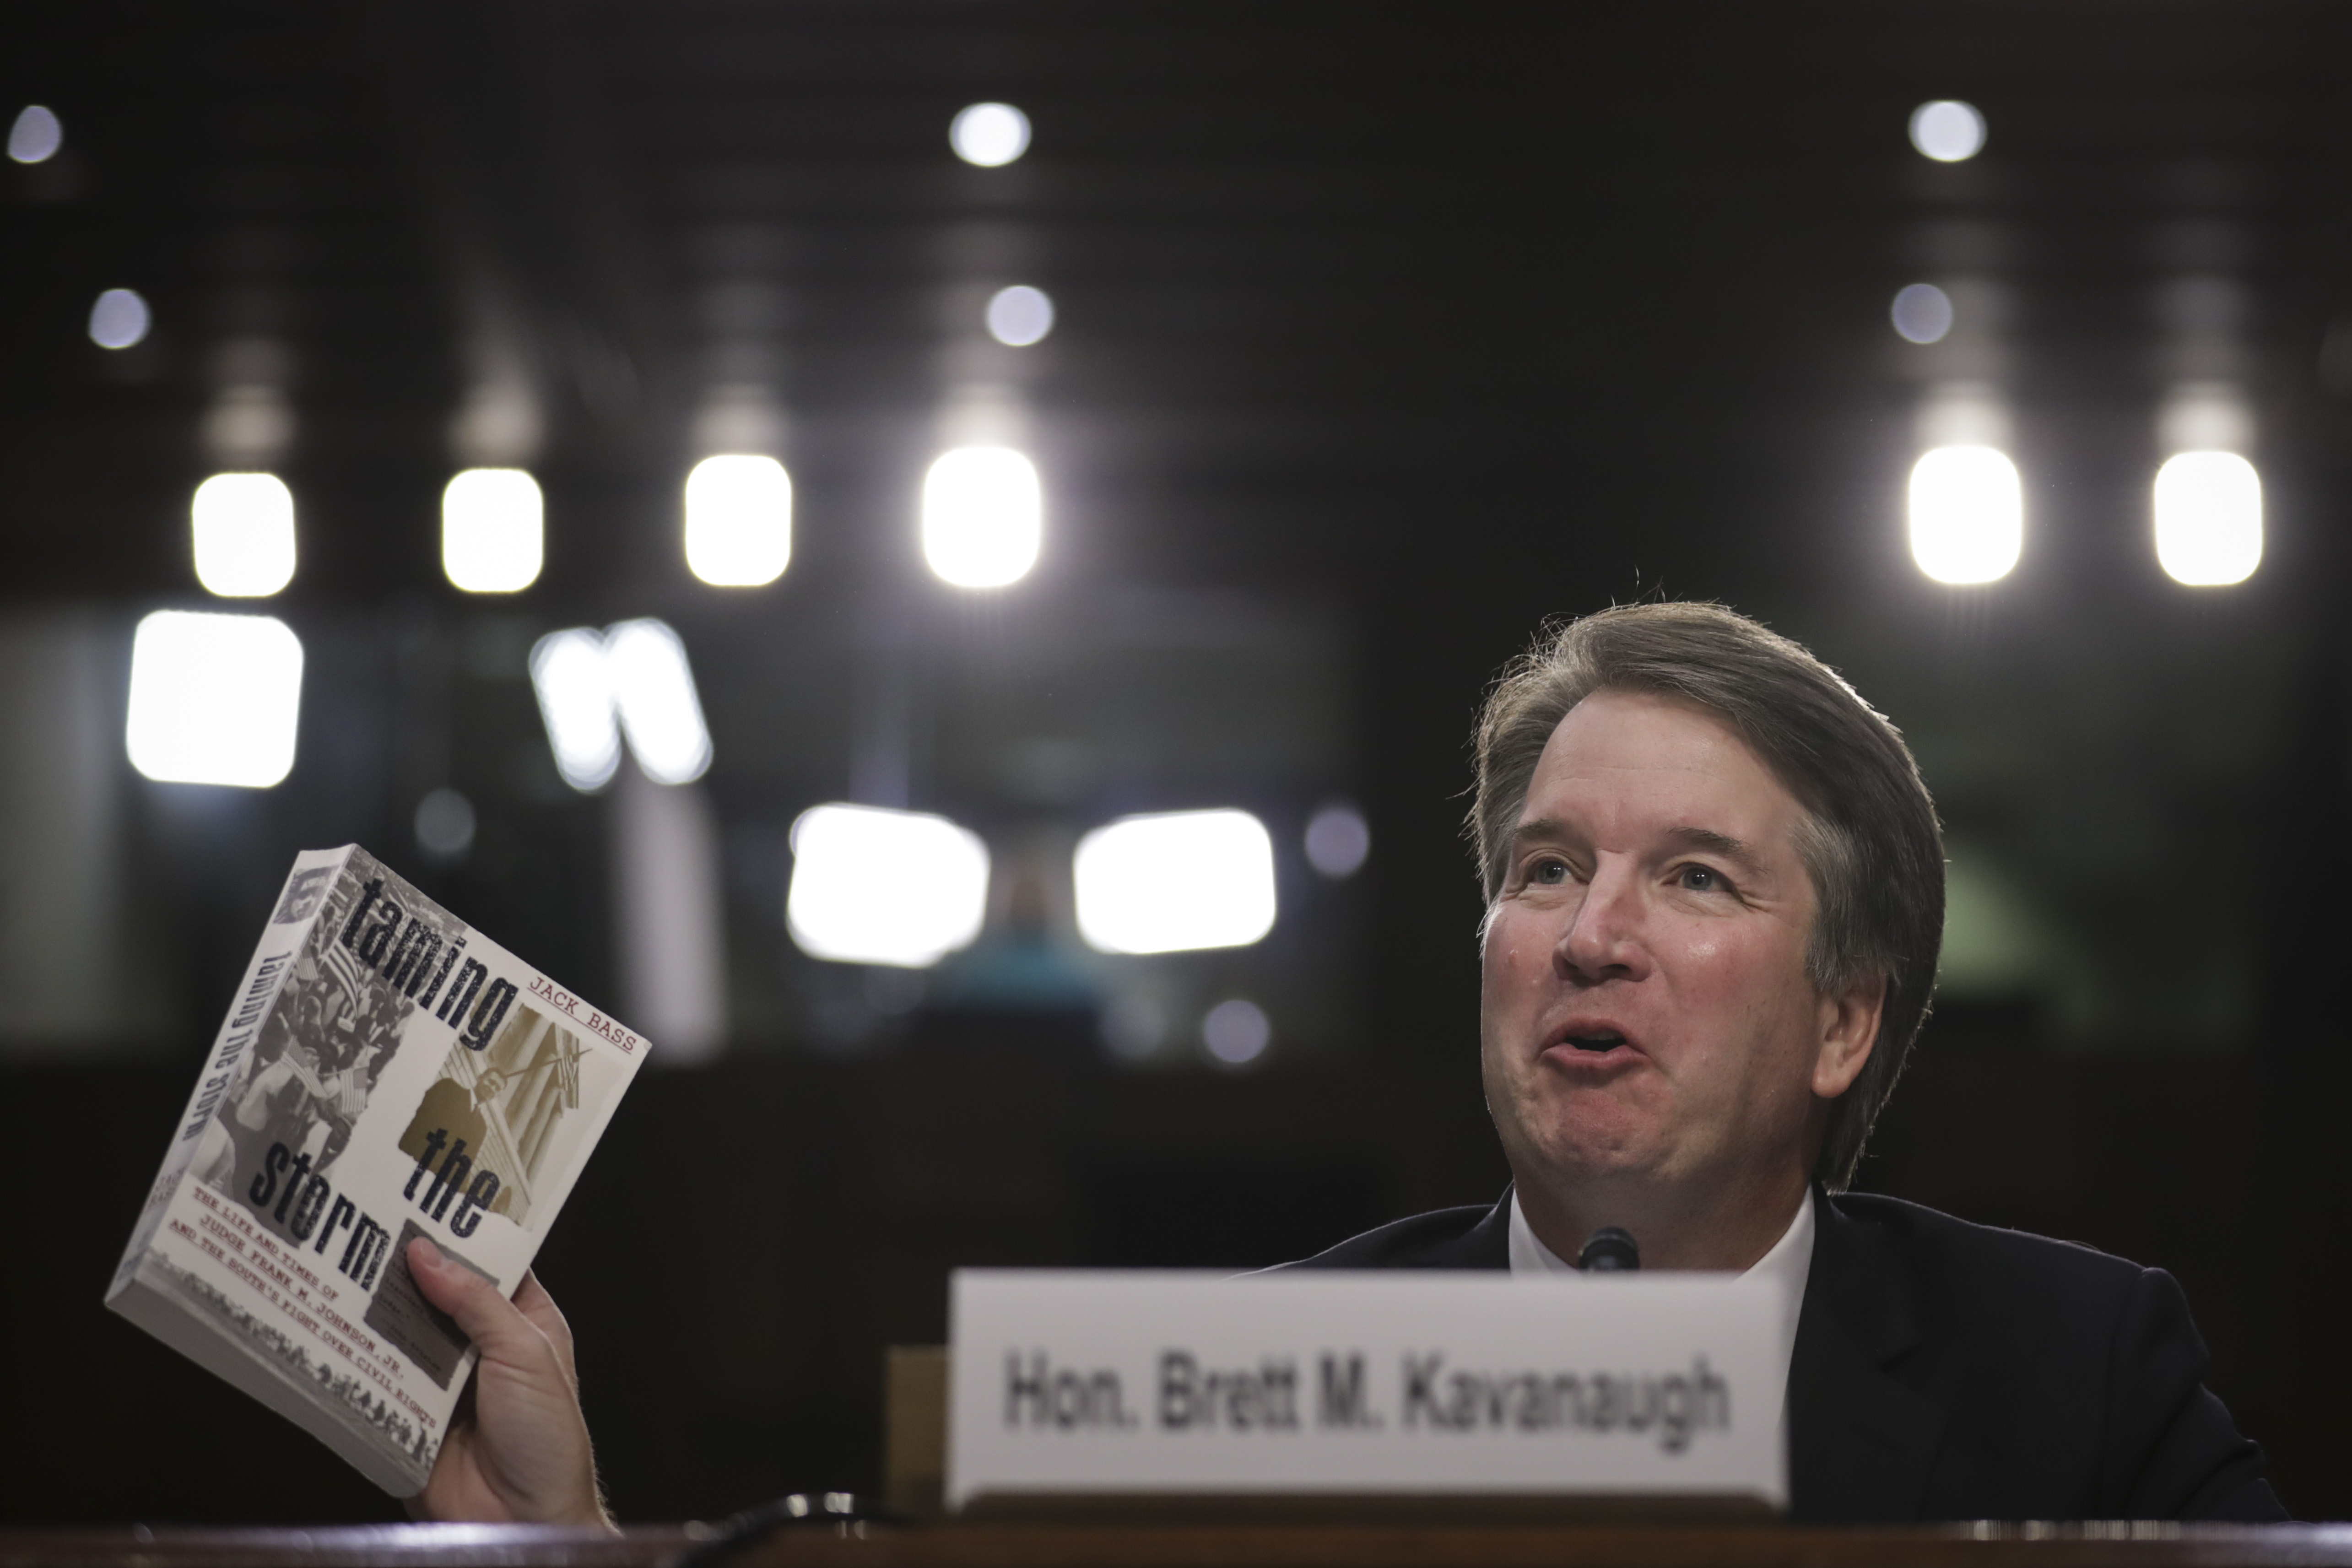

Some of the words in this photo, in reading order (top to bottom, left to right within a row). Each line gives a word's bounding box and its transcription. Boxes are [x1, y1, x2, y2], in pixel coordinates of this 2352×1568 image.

[342, 878, 519, 1051] taming
[530, 977, 579, 1015] JACK
[588, 1012, 637, 1051] BASS
[215, 1029, 253, 1070] the
[249, 1142, 391, 1292] storm
[404, 1128, 500, 1238] the
[195, 1186, 219, 1209] THE
[222, 1206, 254, 1234] LIFE
[256, 1233, 279, 1254] AND
[282, 1253, 319, 1286] TIMES
[323, 1285, 339, 1300] OF
[200, 1214, 246, 1251] JUDGE
[251, 1250, 293, 1289] FRANK
[298, 1287, 312, 1306] M.
[384, 1354, 404, 1379] JR.
[170, 1219, 197, 1239] AND
[201, 1237, 226, 1260] THE
[228, 1257, 280, 1302] SOUTH'S
[282, 1299, 320, 1331] FIGHT
[322, 1330, 353, 1358] OVER
[357, 1356, 392, 1390] CIVIL
[395, 1388, 436, 1428] RIGHTS
[1004, 1348, 1140, 1431] Hon.
[1156, 1348, 1301, 1432] Brett
[1315, 1349, 1384, 1431] M.
[1400, 1349, 1731, 1458] Kavanaugh
